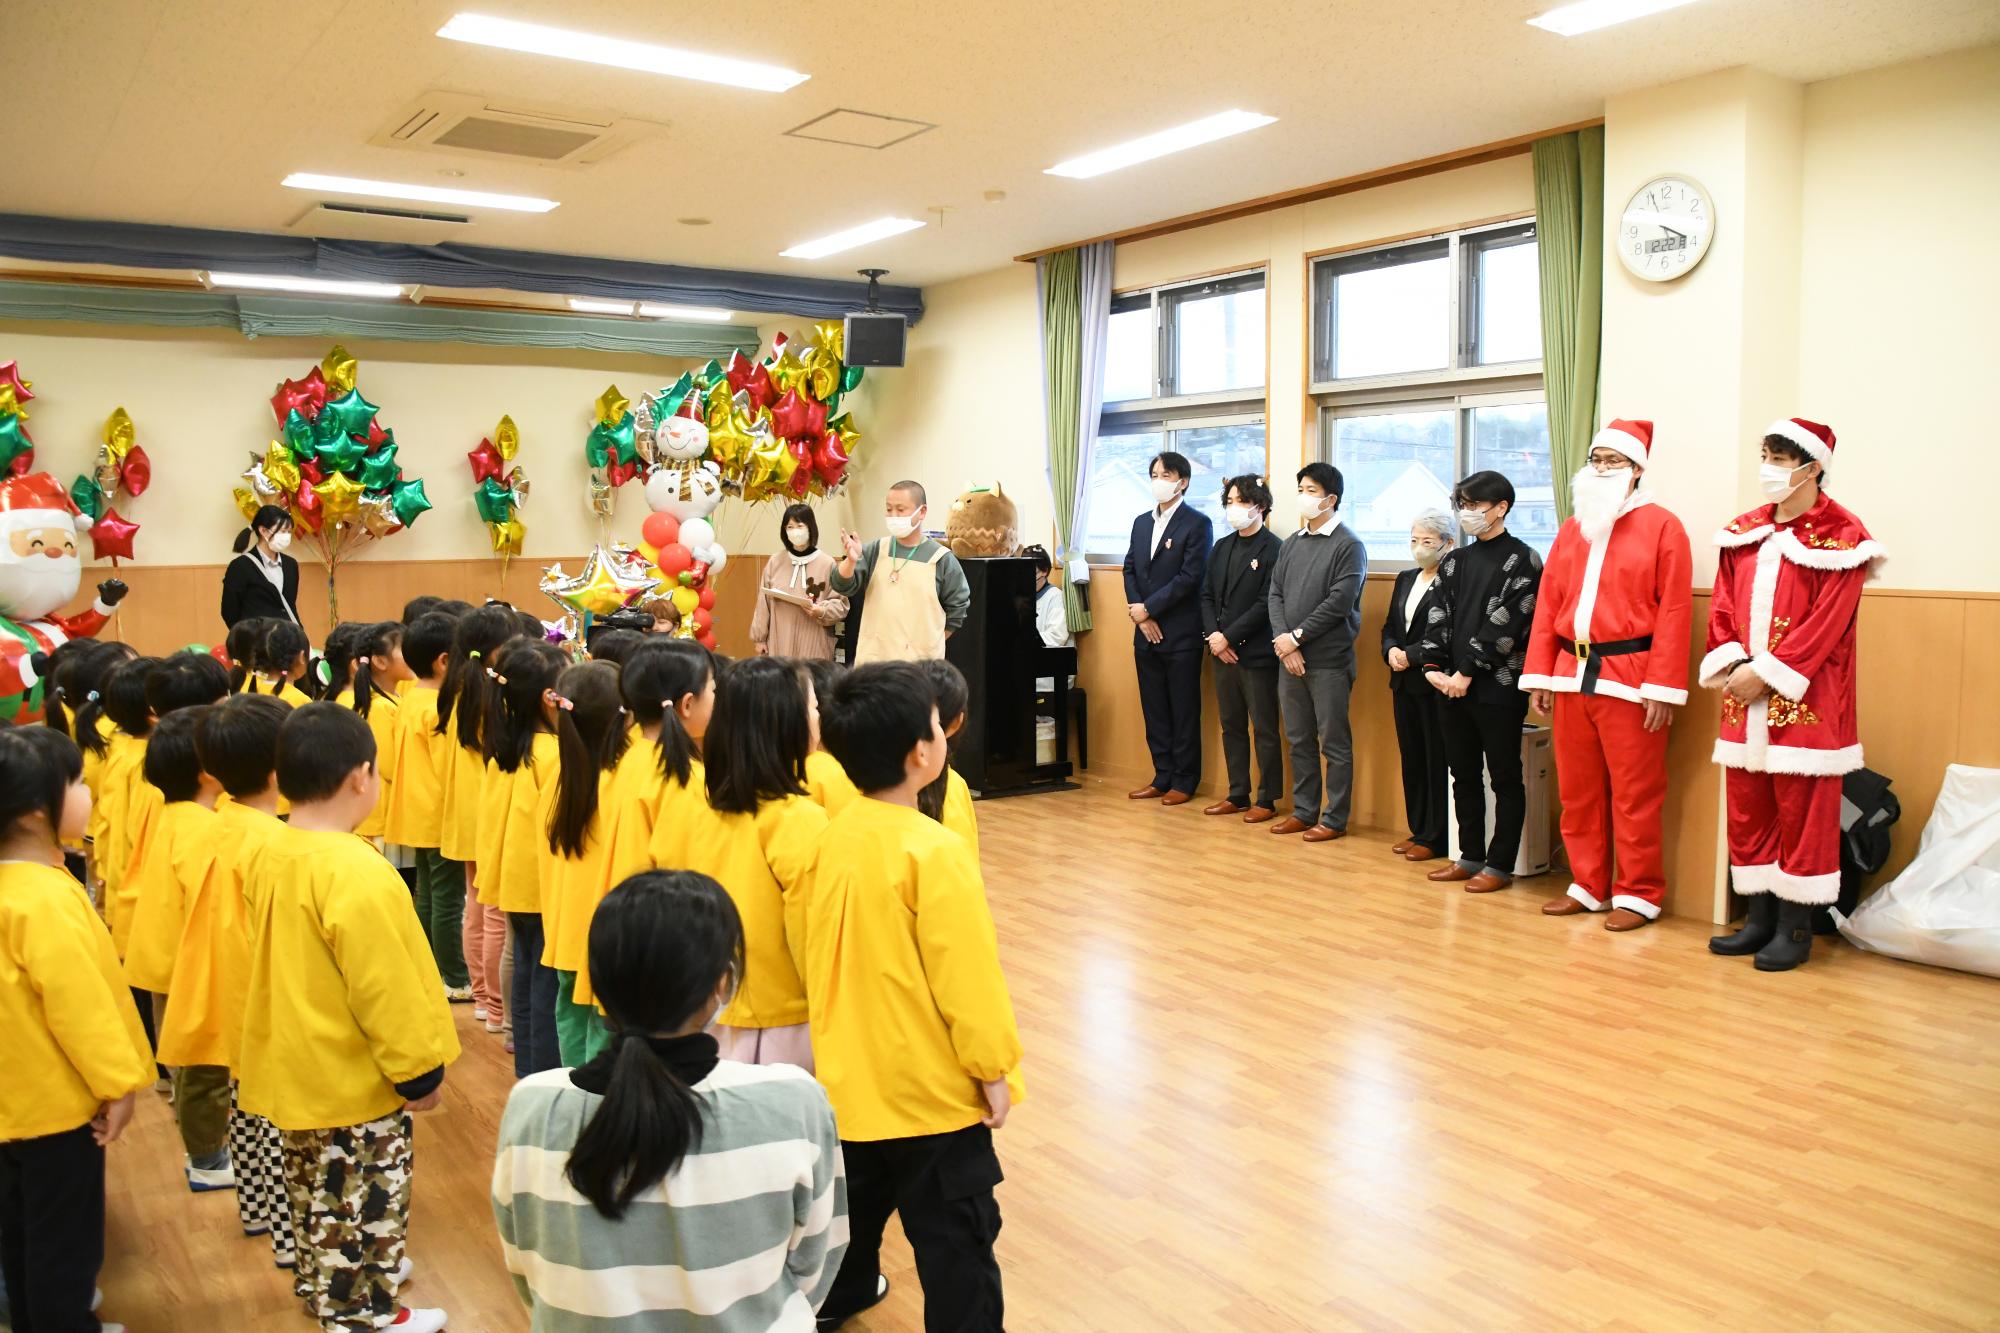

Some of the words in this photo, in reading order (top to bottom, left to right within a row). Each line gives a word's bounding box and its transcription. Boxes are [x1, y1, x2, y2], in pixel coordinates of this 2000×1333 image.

[1661, 185, 1672, 200] 12
[1690, 198, 1699, 213] 2
[1630, 225, 1638, 239] 9
[1689, 235, 1697, 247] 4
[1634, 242, 1642, 256] 8
[1645, 255, 1653, 270] 7
[1661, 255, 1669, 269] 6
[1678, 250, 1686, 263] 5
